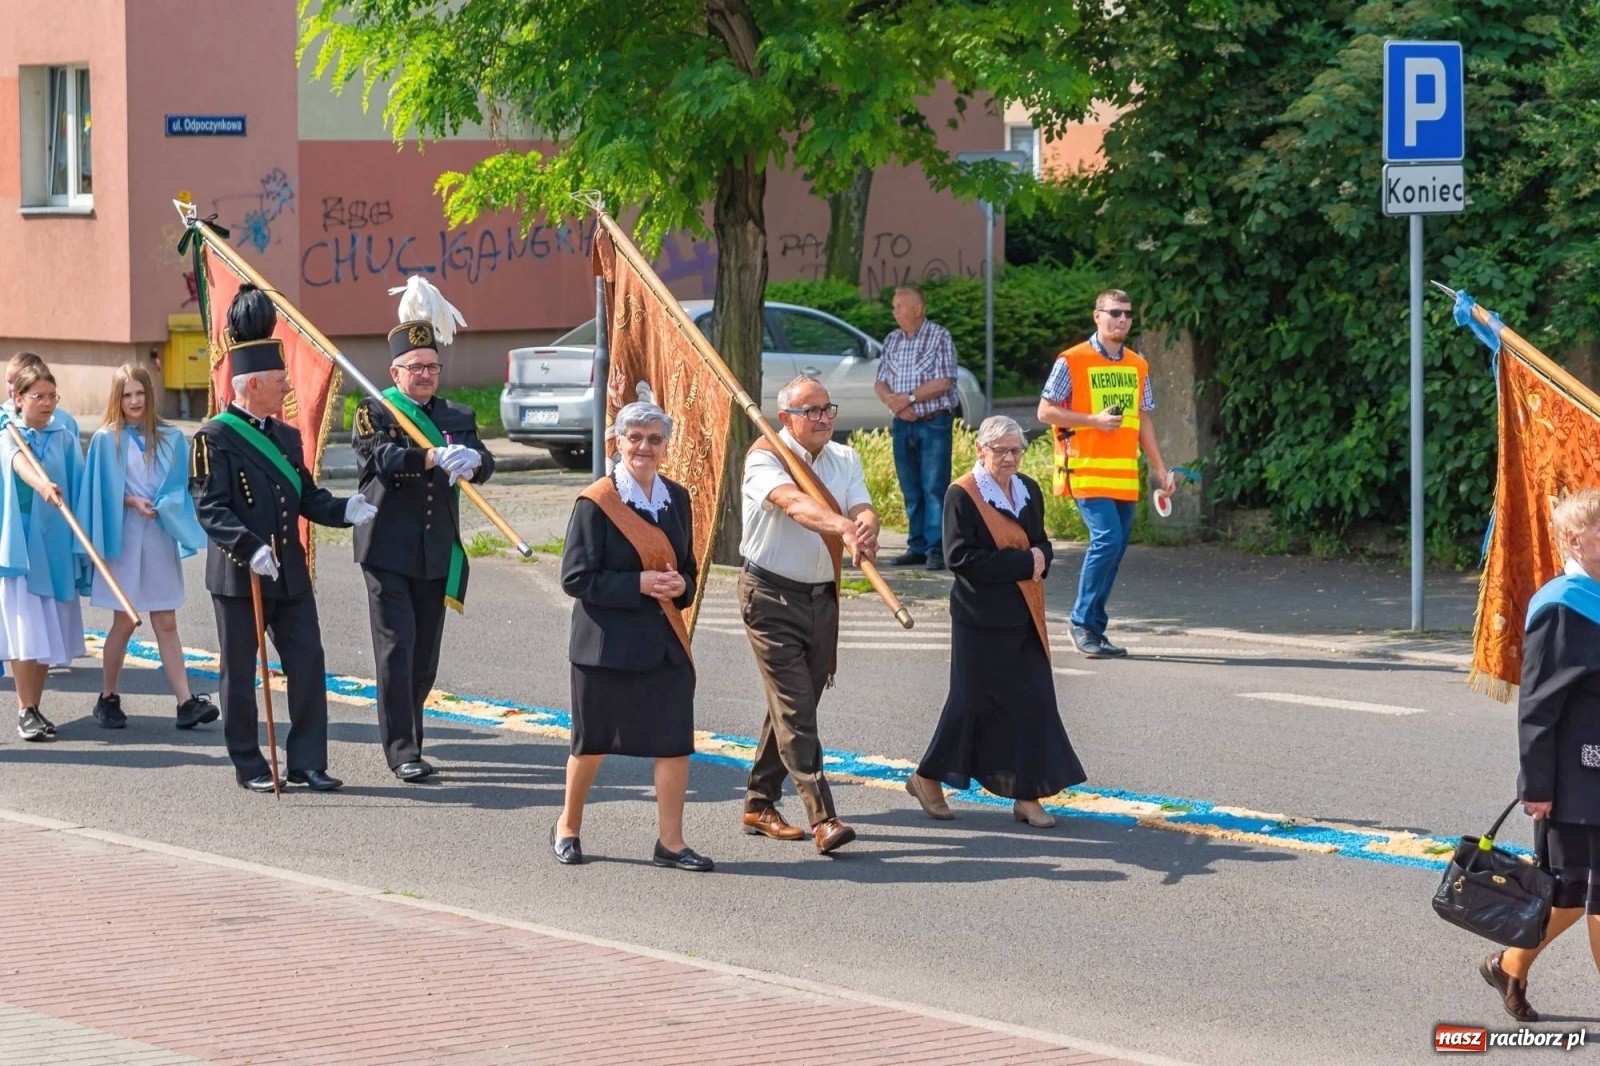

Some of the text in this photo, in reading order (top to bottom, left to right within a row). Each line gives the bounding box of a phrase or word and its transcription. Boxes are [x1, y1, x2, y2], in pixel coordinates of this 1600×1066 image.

[1404, 57, 1447, 147] P
[172, 118, 242, 134] ul. Odpoczynkowa
[1387, 176, 1463, 204] Koniec
